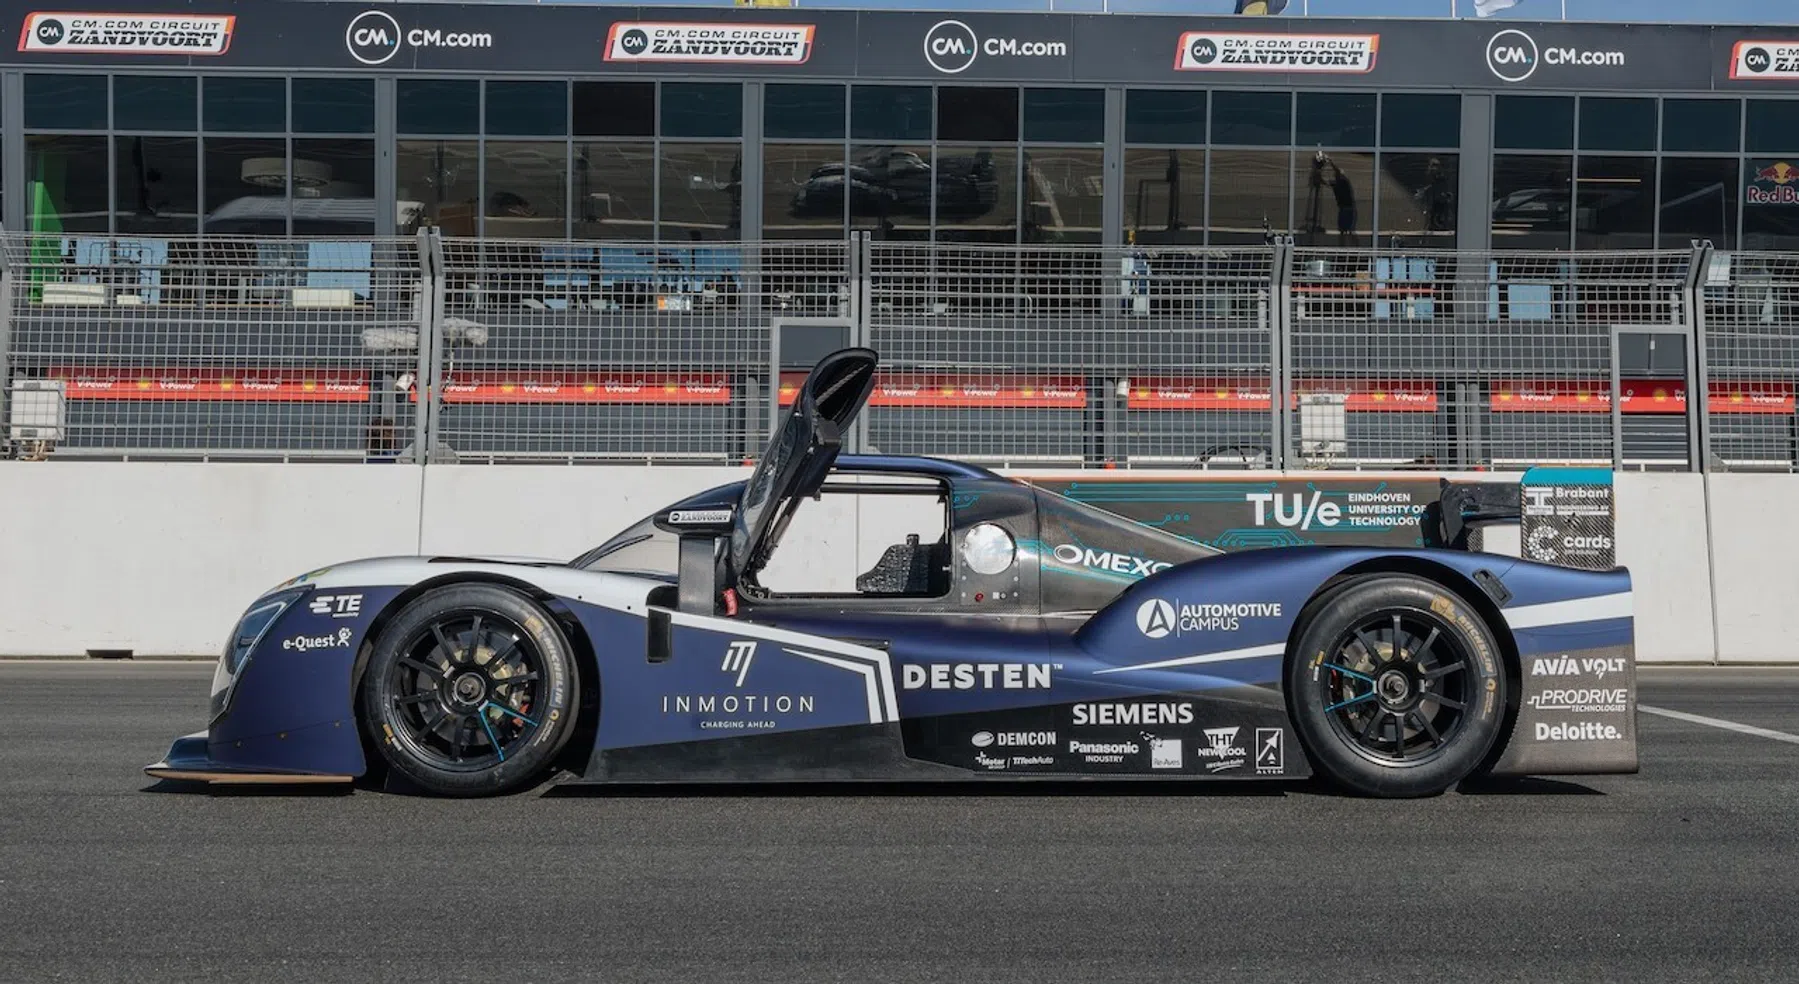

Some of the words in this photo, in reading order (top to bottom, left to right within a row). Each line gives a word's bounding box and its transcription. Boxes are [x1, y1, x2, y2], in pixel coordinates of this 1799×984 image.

[71, 19, 144, 29] CM.COM
[150, 21, 221, 31] CIRCUIT
[67, 29, 218, 47] ZANDVOORT
[407, 29, 492, 48] CM.com
[654, 29, 726, 38] CM.COM
[732, 30, 801, 40] CIRCUIT
[652, 39, 799, 57] ZANDVOORT
[983, 38, 1067, 56] CM.com
[1223, 39, 1292, 49] CM.COM
[1298, 40, 1367, 50] CIRCUIT
[1221, 49, 1364, 66] ZANDVOORT
[1544, 47, 1625, 66] CM.com
[1747, 185, 1781, 203] Red
[1348, 493, 1412, 502] EINDHOVEN
[1555, 487, 1609, 498] Brabant
[1246, 490, 1342, 531] TU/e
[1348, 505, 1410, 514] UNIVERSITY
[1411, 505, 1427, 514] OF
[1349, 516, 1421, 526] TECHNOLOGY
[1563, 534, 1611, 549] cards
[336, 594, 363, 612] TE
[1180, 603, 1282, 617] AUTOMOTIVE
[1180, 617, 1240, 631] CAMPUS
[283, 634, 335, 652] e-Quest
[1581, 658, 1627, 677] VOLT
[663, 695, 814, 713] INMOTION
[1541, 688, 1628, 705] PRODRIVE
[1072, 702, 1195, 725] SIEMENS
[1571, 704, 1627, 713] TECHNOLOGIES
[700, 720, 745, 729] CHARGING
[747, 720, 776, 729] AHEAD
[1535, 722, 1623, 741] Deloitte.
[997, 731, 1057, 746] DEMCON
[1207, 733, 1234, 747] THT
[1069, 740, 1140, 754] Panasonic
[1085, 755, 1124, 763] INDUSTRY
